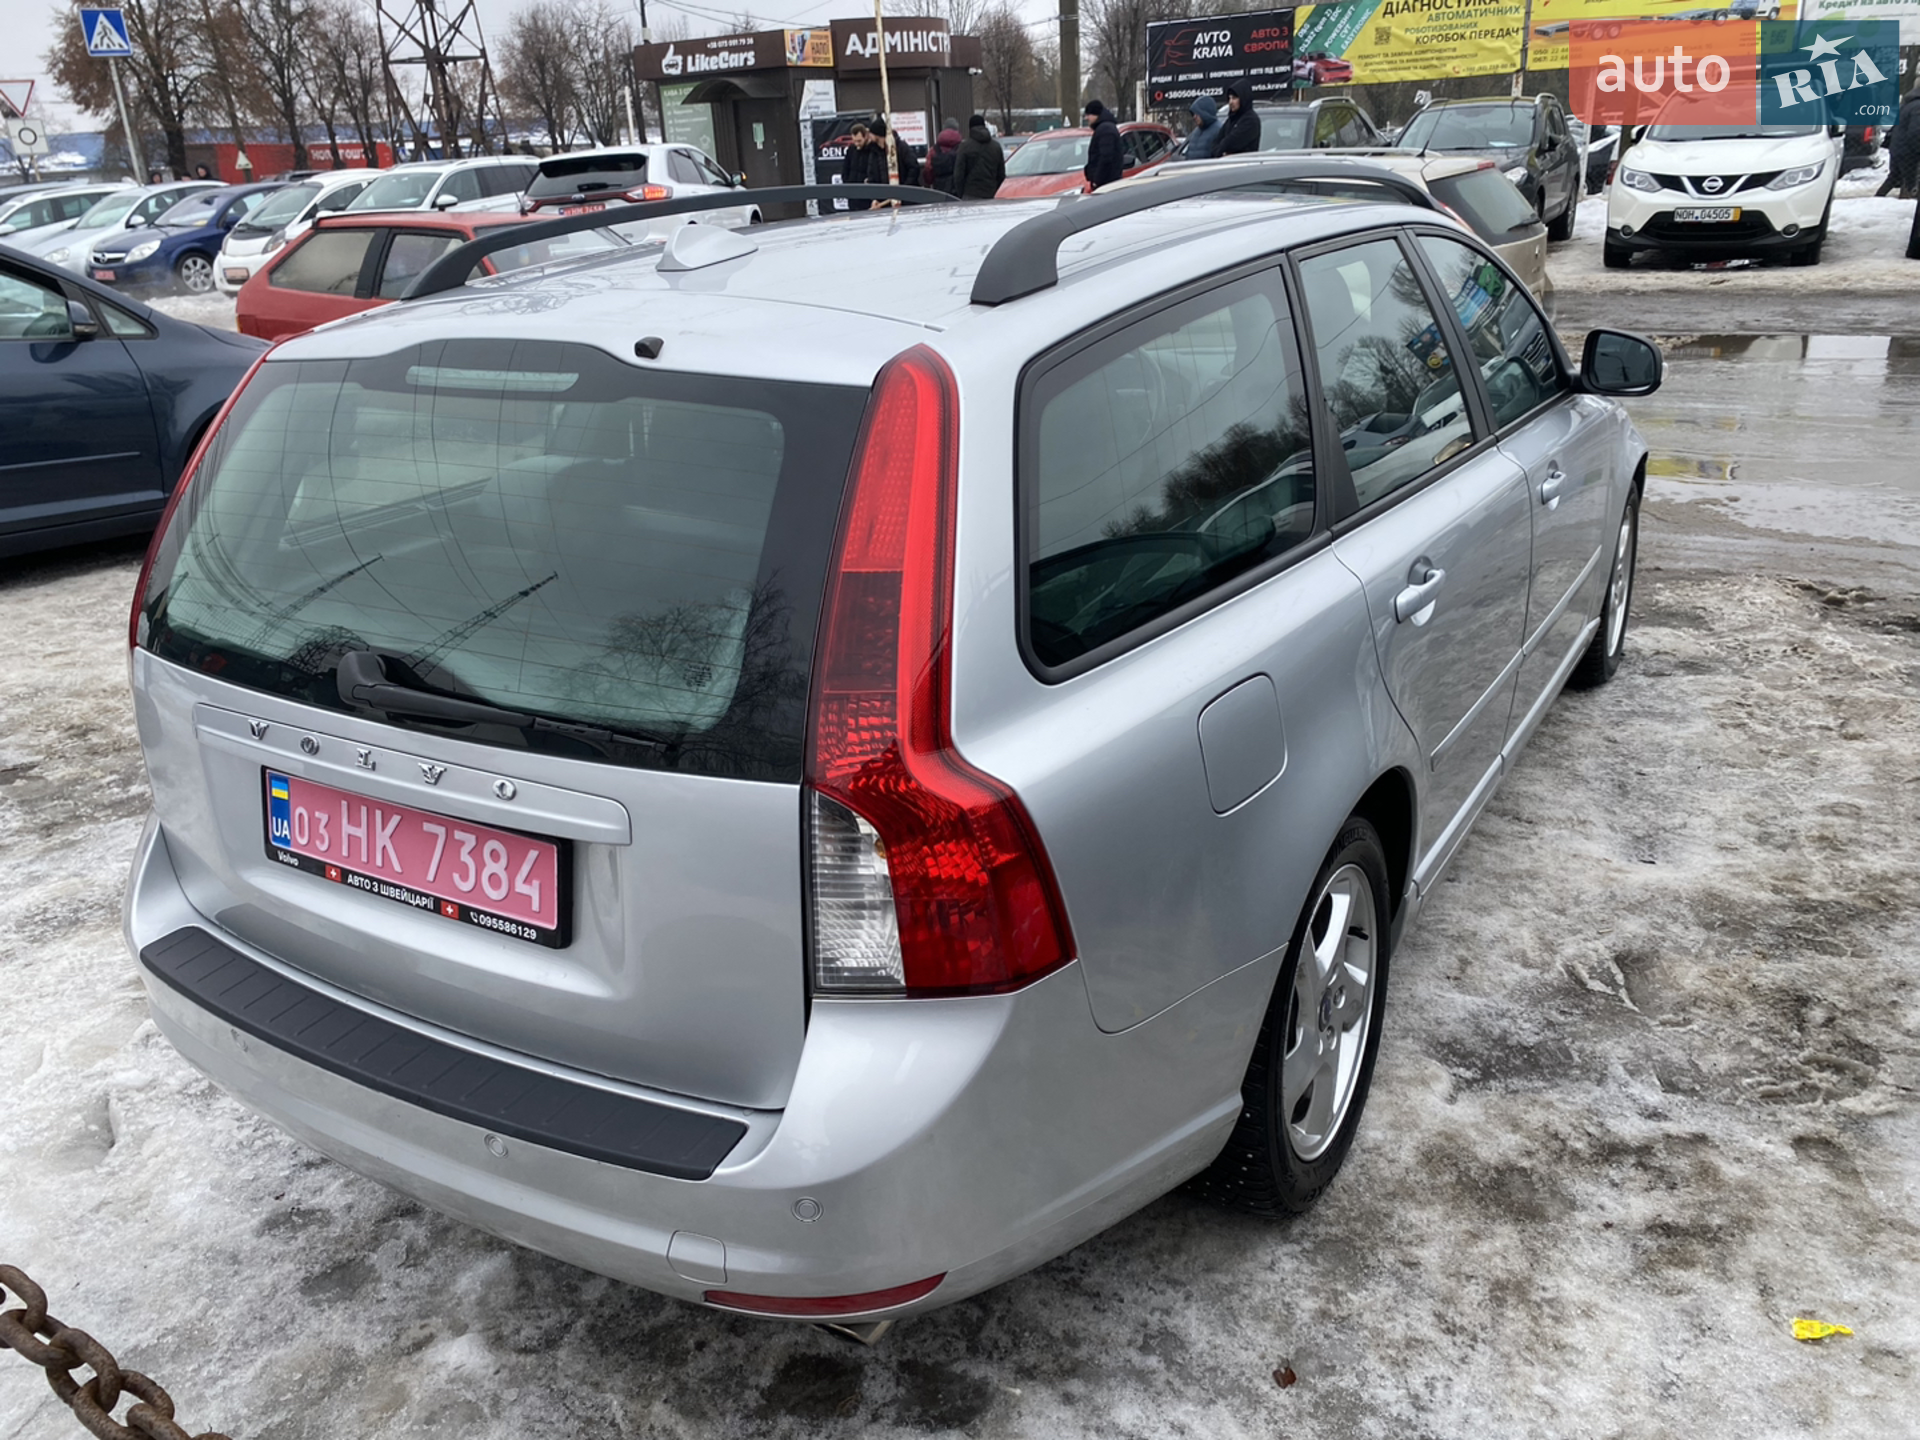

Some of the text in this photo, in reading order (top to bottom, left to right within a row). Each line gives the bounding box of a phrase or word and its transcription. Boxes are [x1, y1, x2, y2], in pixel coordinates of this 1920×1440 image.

[1426, 5, 1521, 23] АВТОМАТИЧНИХ
[1251, 28, 1280, 39] АВТО
[1324, 5, 1356, 48] POWERSHIFT
[1194, 30, 1231, 46] AVTO
[1415, 26, 1520, 46] КОРОБОК ПЕРЕДАЧ
[1192, 45, 1233, 60] KRAVA
[1243, 40, 1289, 53] ЄВРОПИ
[686, 50, 756, 73] LikeCars
[821, 146, 842, 157] DEN
[1675, 209, 1731, 220] NOH 04505
[248, 719, 517, 801] VOLVO
[272, 816, 291, 840] UA
[277, 850, 299, 868] Volvo
[294, 806, 330, 853] 03
[422, 821, 542, 913] 7384
[347, 873, 371, 891] АВТО
[380, 879, 435, 911] ШВЕЙЦАРІЇ
